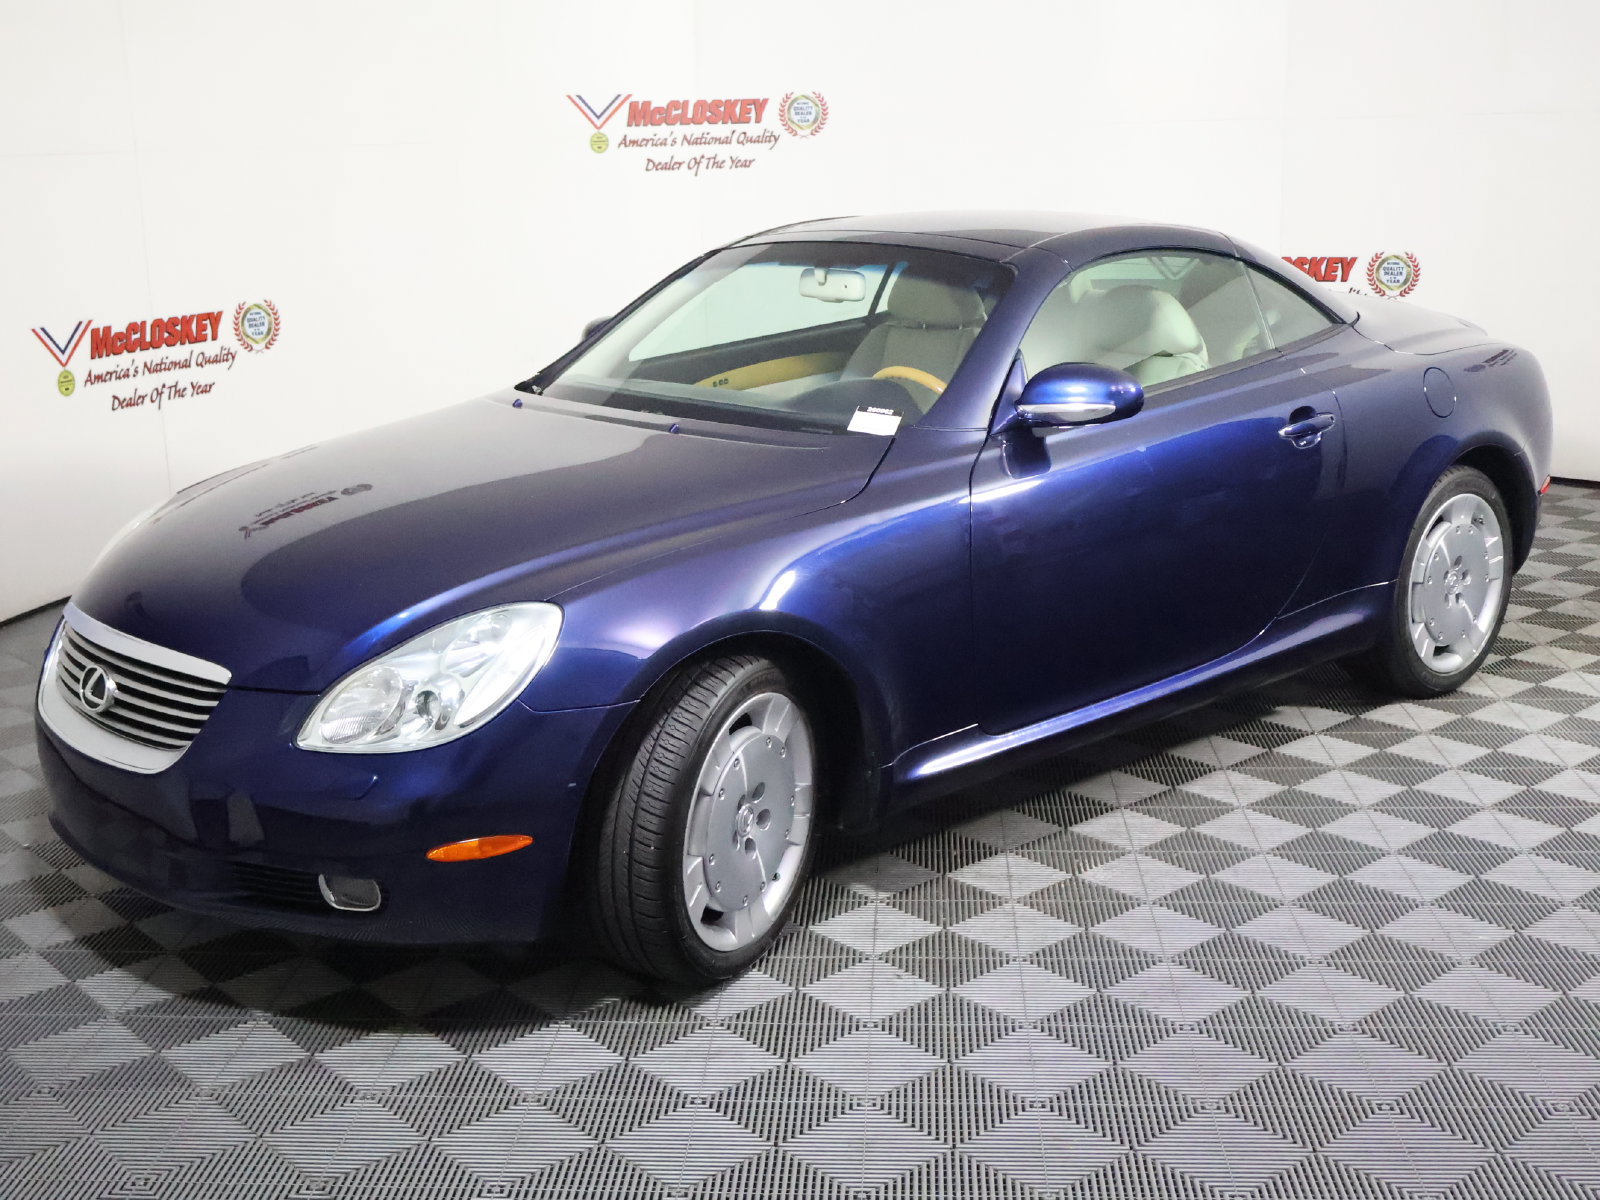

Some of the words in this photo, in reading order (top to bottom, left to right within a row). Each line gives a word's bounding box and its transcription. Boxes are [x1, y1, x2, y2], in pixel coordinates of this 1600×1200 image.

[626, 98, 770, 127] McCLOSKEY
[617, 131, 677, 149] America's
[681, 130, 735, 147] National
[736, 128, 780, 151] Quality
[645, 155, 685, 172] Dealer
[687, 153, 705, 177] Of
[705, 155, 726, 170] The
[729, 155, 756, 169] Year
[90, 310, 224, 360] McCLOSKEY
[84, 359, 139, 387] America's
[142, 349, 192, 376] National
[195, 346, 238, 370] Quality
[111, 388, 148, 412] Dealer
[150, 382, 166, 411] Of
[166, 381, 188, 401] The
[190, 380, 216, 397] Year
